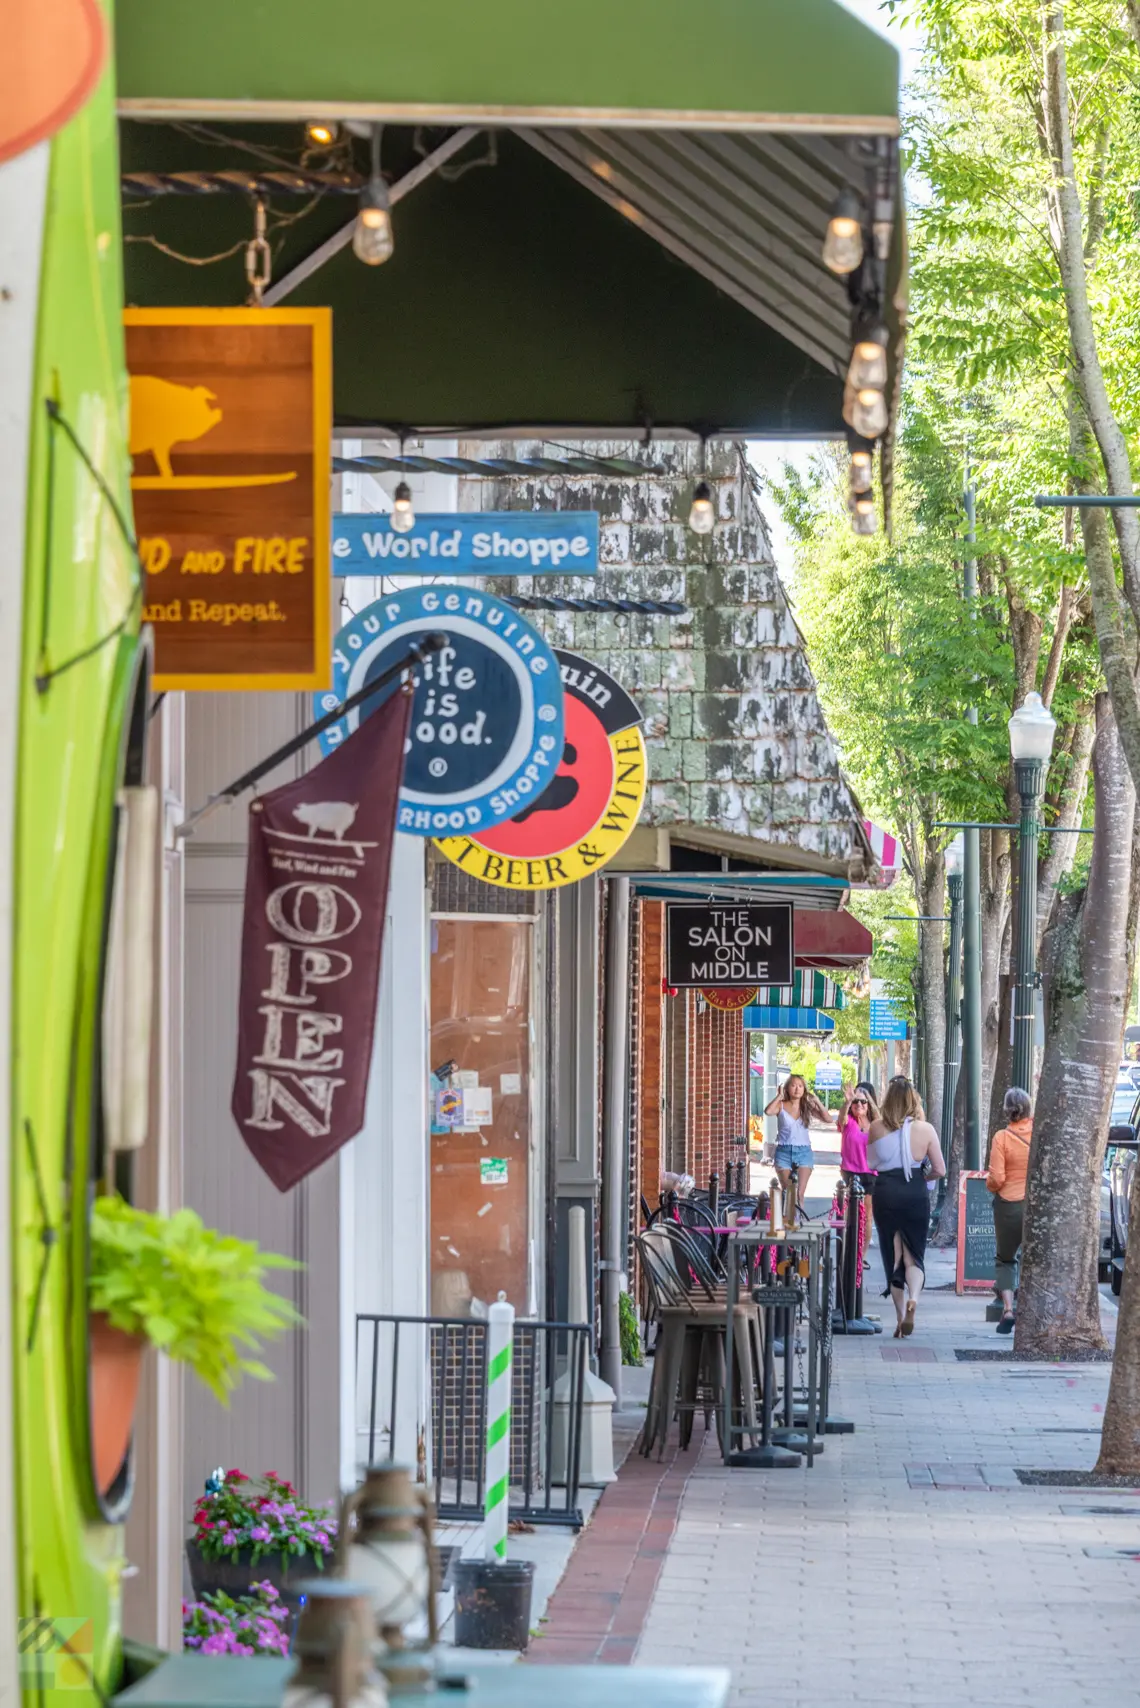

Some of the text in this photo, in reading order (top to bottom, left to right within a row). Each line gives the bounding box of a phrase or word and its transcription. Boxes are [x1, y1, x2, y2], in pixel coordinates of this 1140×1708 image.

[234, 537, 308, 574] FIRE
[362, 530, 462, 558] World
[472, 532, 590, 565] Shoppe
[188, 599, 287, 626] Repeat.
[332, 591, 549, 675] your Genuine
[424, 689, 459, 717] is
[404, 710, 492, 754] ood.
[489, 734, 556, 816] Shoppe
[481, 854, 569, 886] BEER
[577, 841, 607, 867] &
[600, 734, 642, 834] WINE
[710, 911, 749, 926] THE
[688, 926, 772, 947] SALON
[714, 946, 746, 961] ON
[691, 961, 769, 979] MIDDLE
[244, 880, 362, 1138] OPEN
